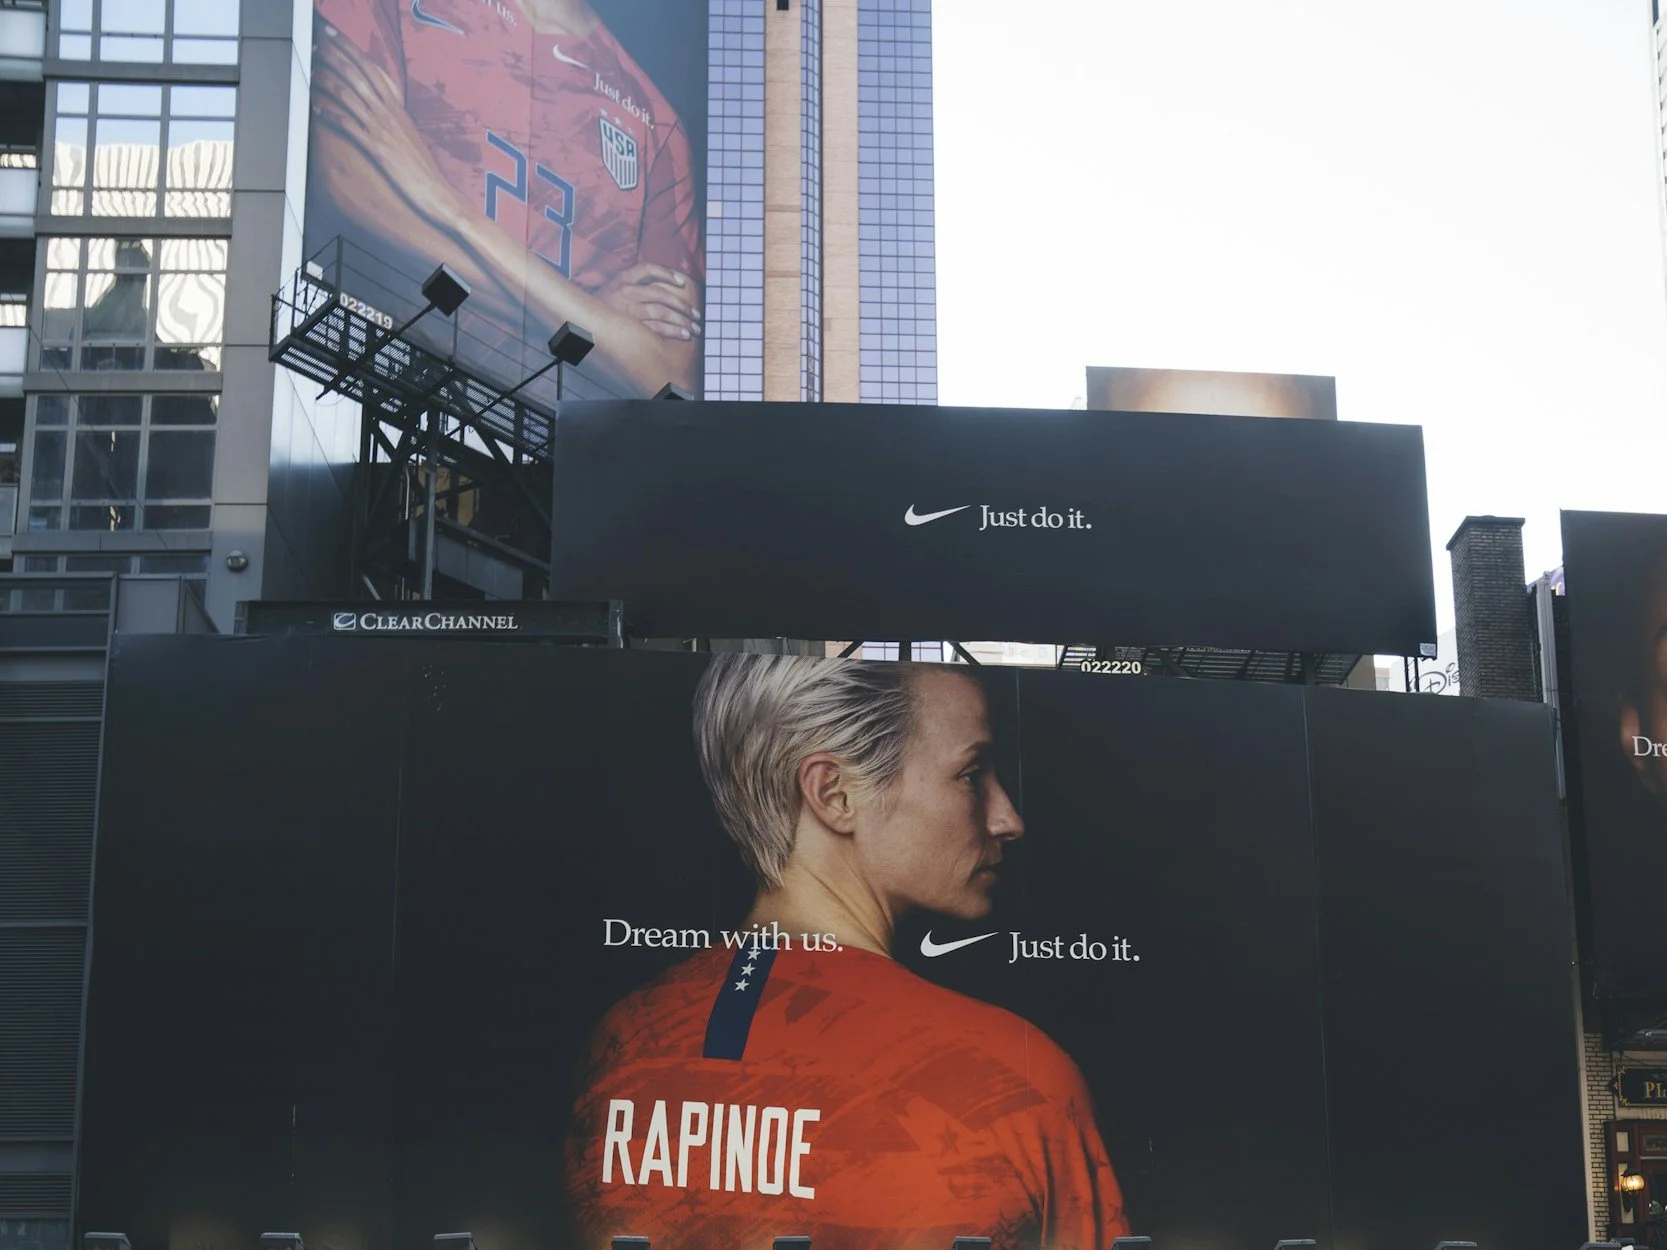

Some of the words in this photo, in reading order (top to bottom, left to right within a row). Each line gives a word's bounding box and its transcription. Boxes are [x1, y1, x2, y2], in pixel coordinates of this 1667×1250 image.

[594, 73, 620, 104] Just
[621, 97, 640, 118] do
[641, 107, 655, 130] it.
[602, 122, 636, 158] USA
[484, 129, 576, 280] 23
[340, 292, 394, 330] 022219
[979, 505, 1028, 531] Just
[1031, 506, 1063, 528] do
[1068, 508, 1092, 529] it.
[1081, 661, 1142, 674] 022220
[603, 919, 712, 949] Dream
[720, 921, 792, 951] with
[802, 931, 844, 952] us.
[1009, 931, 1064, 963] Just
[1070, 934, 1107, 961] do
[1112, 936, 1140, 961] it.
[602, 1099, 821, 1200] RAPINOE
